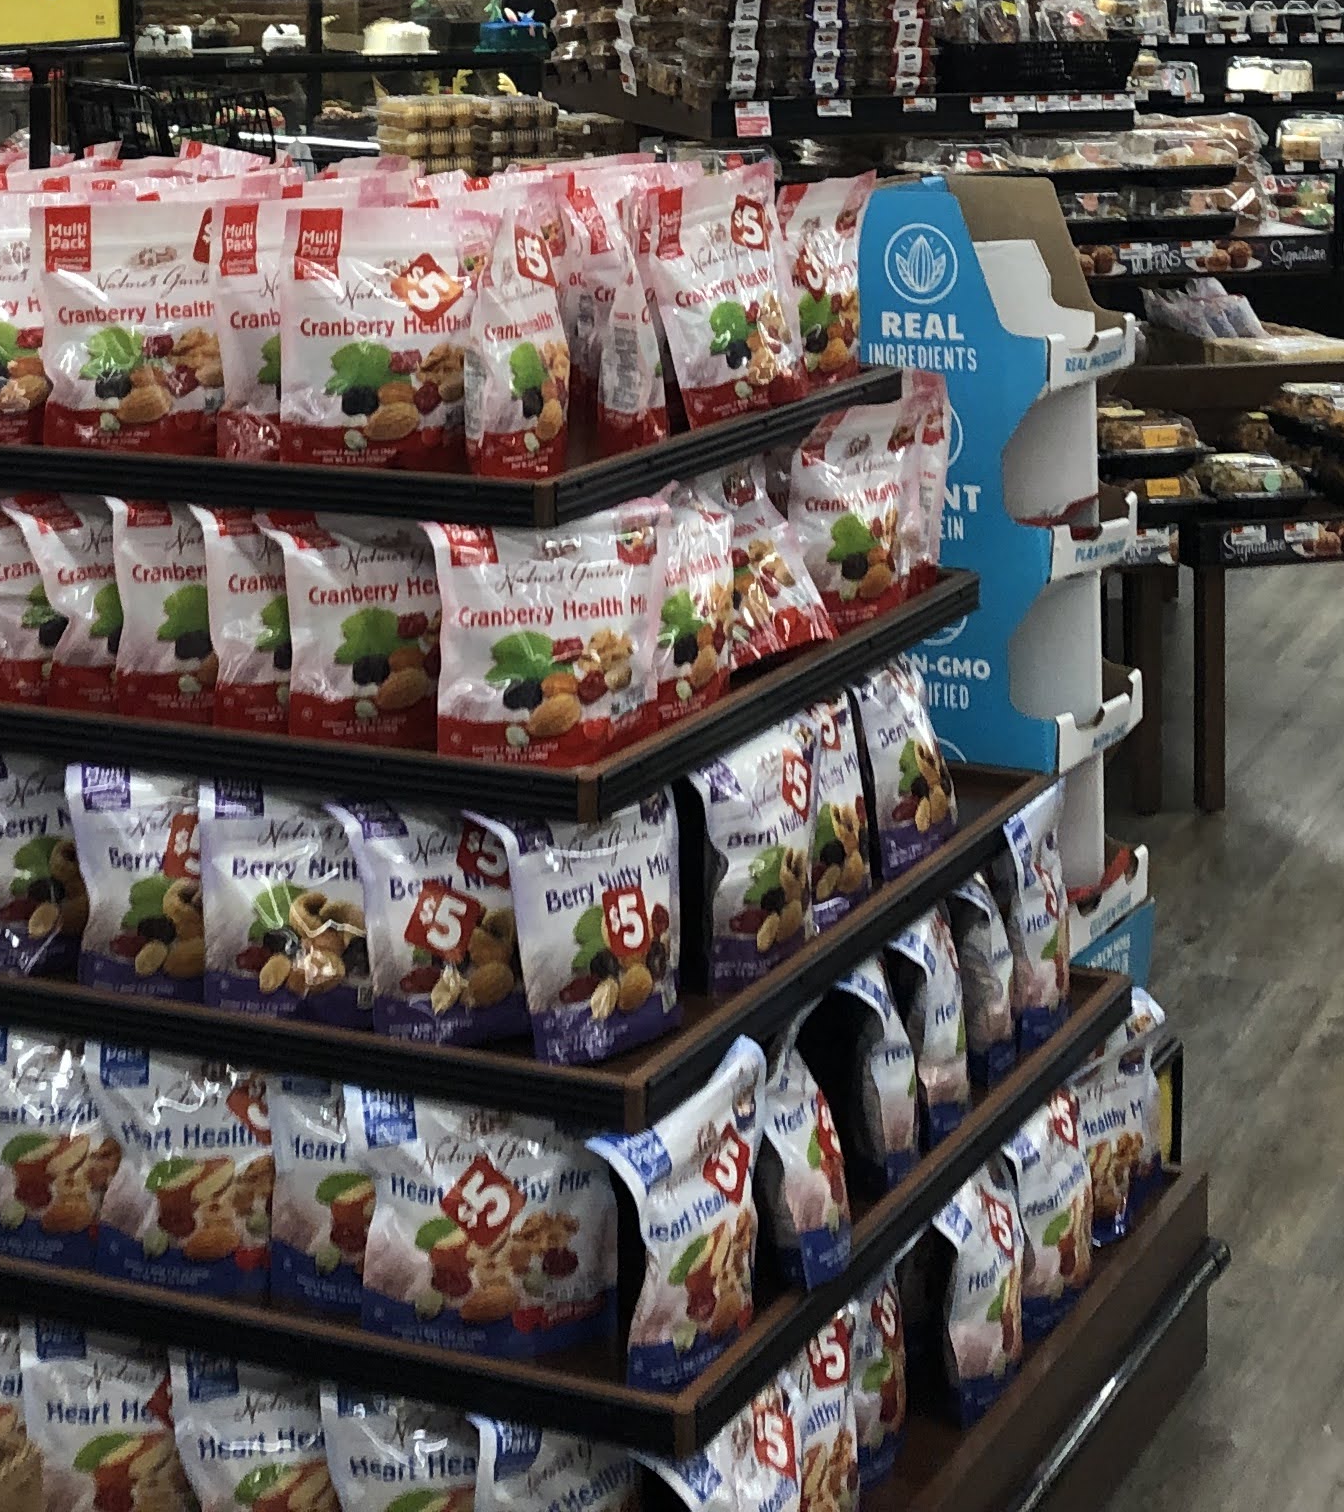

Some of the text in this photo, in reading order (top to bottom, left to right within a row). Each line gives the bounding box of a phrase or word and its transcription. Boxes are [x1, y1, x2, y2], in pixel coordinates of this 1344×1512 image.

[48, 221, 88, 239] Multi
[223, 220, 254, 240] Multi
[301, 229, 340, 247] Multi
[734, 202, 765, 247] $5
[50, 235, 87, 252] Pack
[224, 236, 254, 253] Pack
[301, 242, 336, 258] Pack
[1269, 239, 1328, 270] Signature
[516, 236, 547, 280] $5
[57, 305, 146, 327] Cranberry
[229, 310, 281, 331] Cranb
[300, 315, 395, 338] Cranberry
[880, 311, 965, 341] REAL
[867, 342, 978, 372] INGREDIENTS
[307, 584, 399, 605] Cranberry
[458, 597, 624, 627] Cranberry Health
[782, 759, 809, 816] $5
[726, 826, 779, 851] Berry
[108, 846, 167, 872] Berry
[231, 855, 298, 881] Berry
[464, 830, 507, 879] $5
[544, 865, 643, 915] Berry Nutty
[417, 894, 469, 953] $5
[607, 892, 646, 951] $5
[557, 1168, 592, 1191] Mix
[990, 1204, 1014, 1252] $5
[808, 1330, 848, 1383] $5
[46, 1398, 110, 1426] Heart
[756, 1410, 792, 1471] $5
[349, 1455, 418, 1482] Heart
